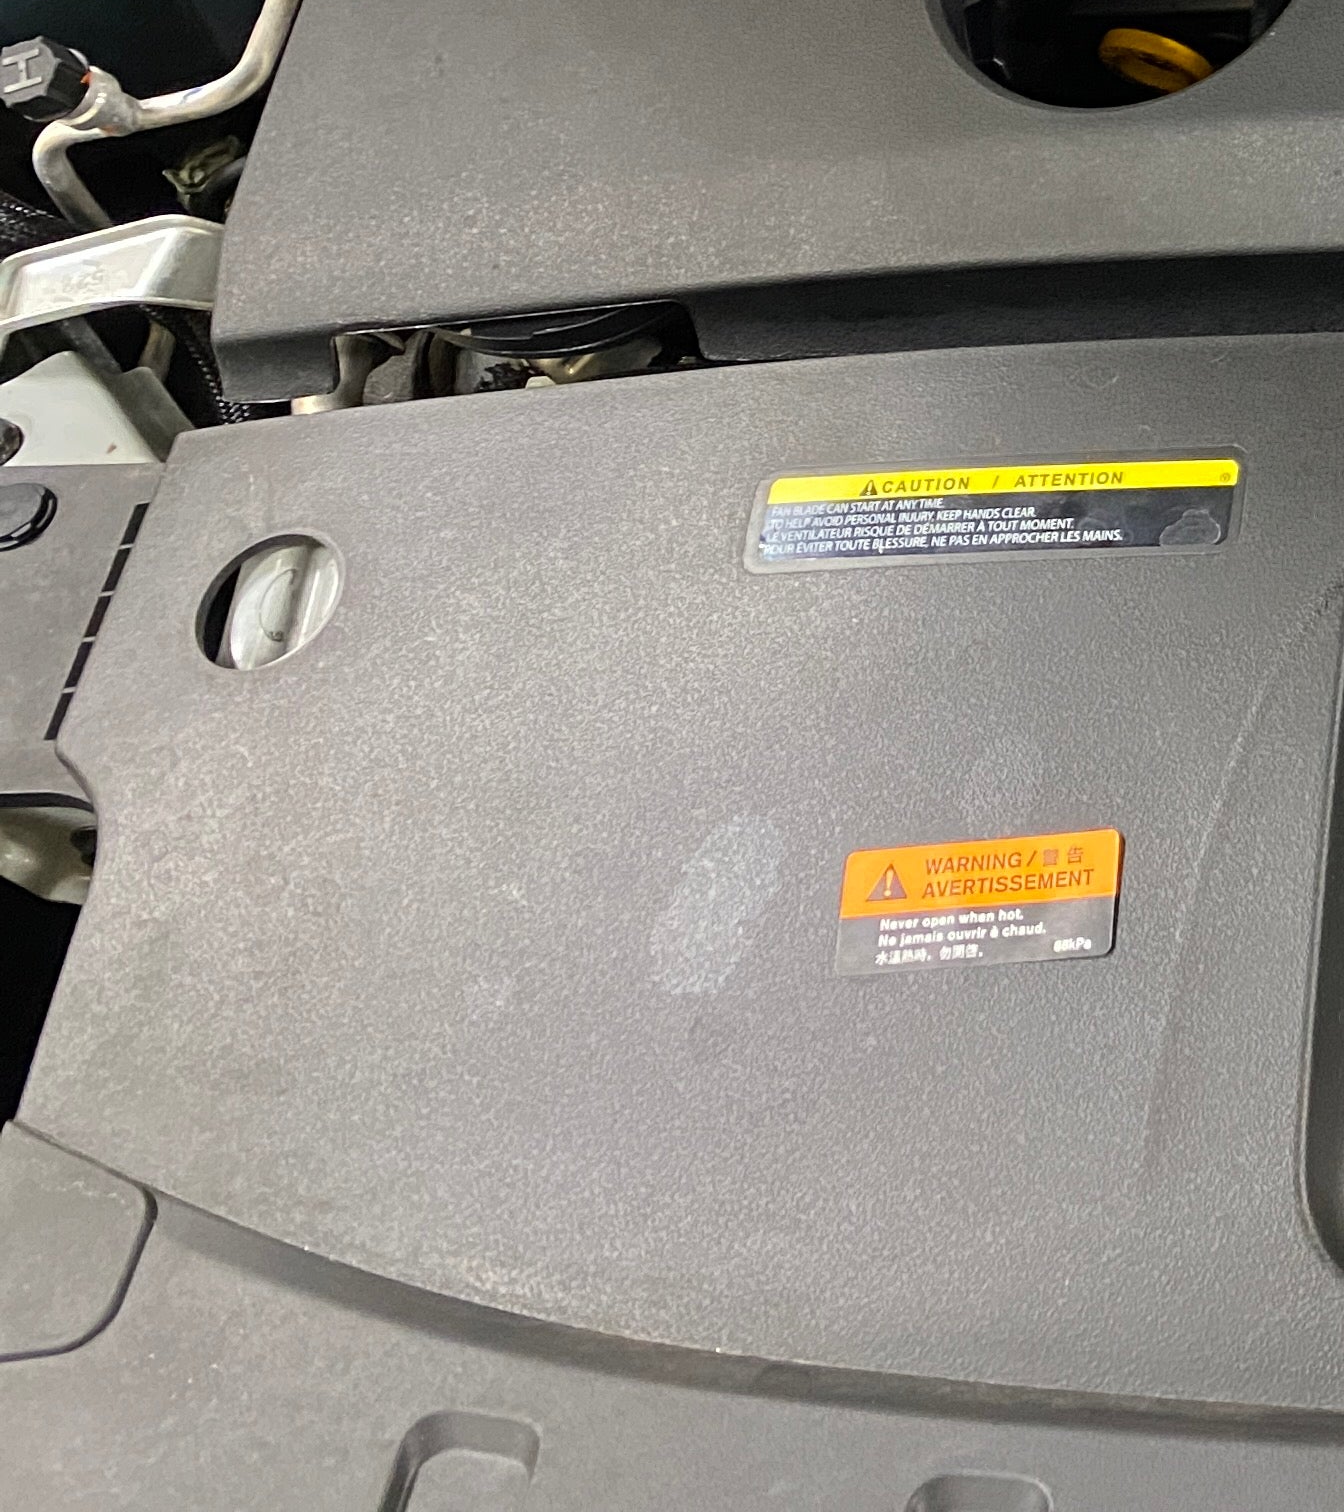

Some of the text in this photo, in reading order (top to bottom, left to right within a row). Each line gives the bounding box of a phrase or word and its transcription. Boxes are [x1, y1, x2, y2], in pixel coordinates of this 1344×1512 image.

[882, 477, 970, 494] CAUTION
[1014, 471, 1124, 488] ATTENTION
[769, 519, 784, 529] TO
[785, 517, 811, 529] HELP
[811, 516, 843, 527] AVOID
[844, 513, 896, 525] PERSONAL
[936, 509, 962, 521] KEEP
[963, 508, 1001, 520] HANDS
[772, 506, 791, 516] FAN
[793, 504, 826, 516] BLADE
[827, 502, 849, 514] CAN
[850, 500, 881, 513] START
[881, 500, 895, 511] AT
[895, 499, 918, 510] ANY
[764, 542, 795, 555] POUR
[796, 540, 834, 554] ÉVITER
[834, 538, 871, 551] TOUTE
[930, 535, 947, 547] NE
[948, 534, 970, 546] PAS
[971, 534, 988, 546] EN
[988, 531, 1059, 545] APPROCHER
[1059, 530, 1080, 543] LES
[1081, 529, 1123, 541] MAINS.
[766, 518, 1074, 543] LE VENTILATEUR RISQUE DE DÉMARRER À TOUT MOMENT.
[925, 851, 1022, 875] WARNING
[921, 868, 1095, 899] AVERTISSEMENT
[879, 908, 1023, 931] Never open when hot.
[878, 934, 897, 948] Ne
[899, 930, 943, 947] jamais
[947, 925, 987, 941] ouvrir
[1001, 922, 1047, 937] chaud.
